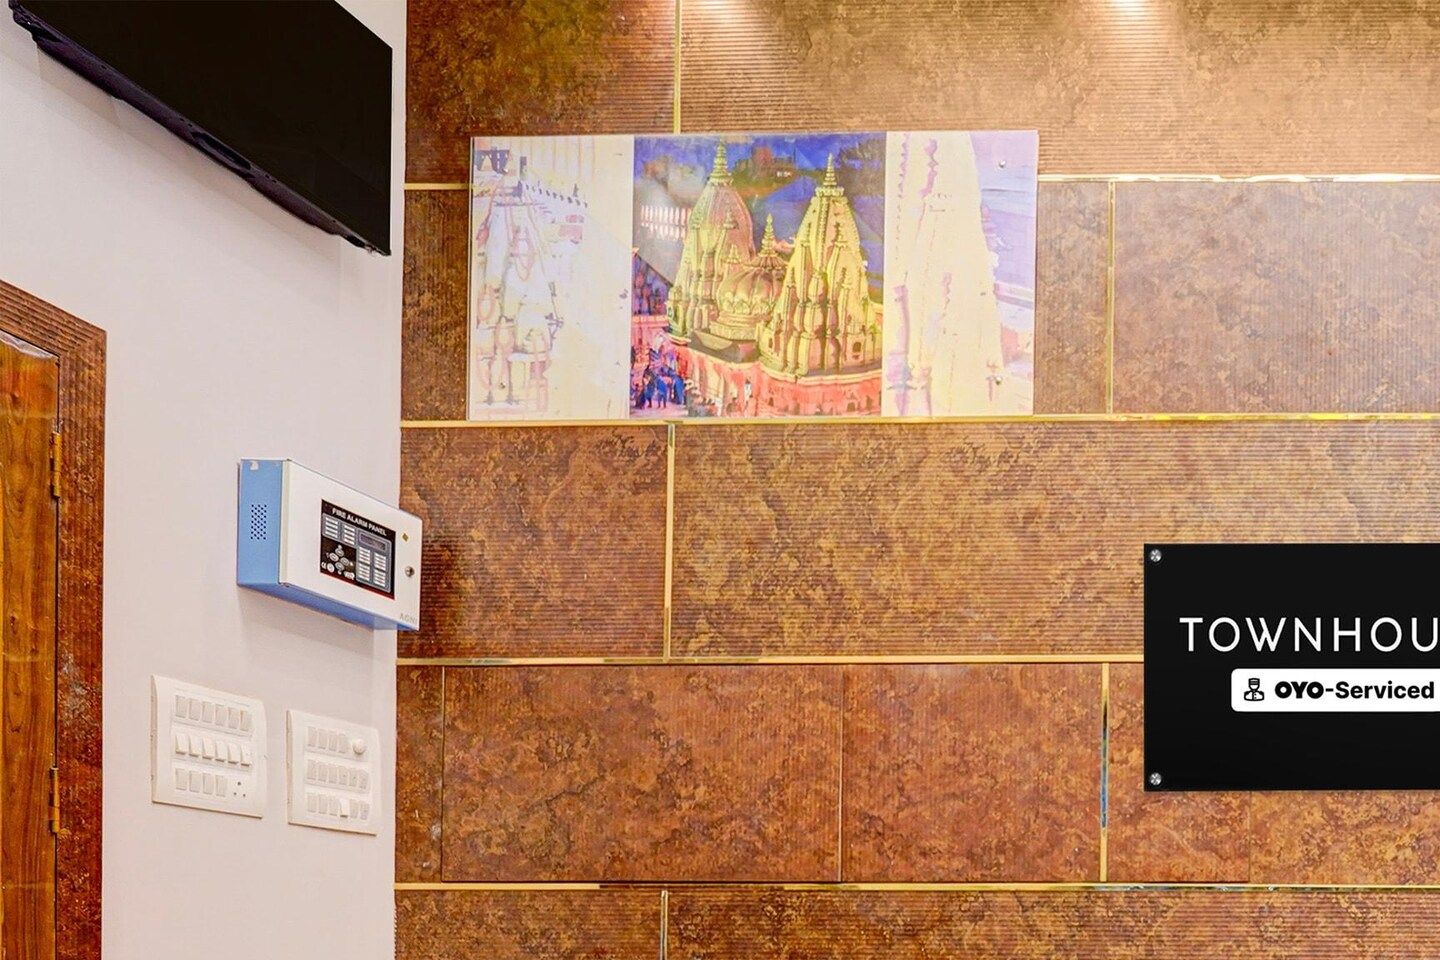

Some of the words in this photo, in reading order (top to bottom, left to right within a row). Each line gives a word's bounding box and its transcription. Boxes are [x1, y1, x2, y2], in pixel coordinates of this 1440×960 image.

[332, 507, 347, 519] FIRE
[347, 514, 368, 528] ALARM
[369, 523, 387, 536] PANEL
[1274, 680, 1435, 700] OYO-Serviced
